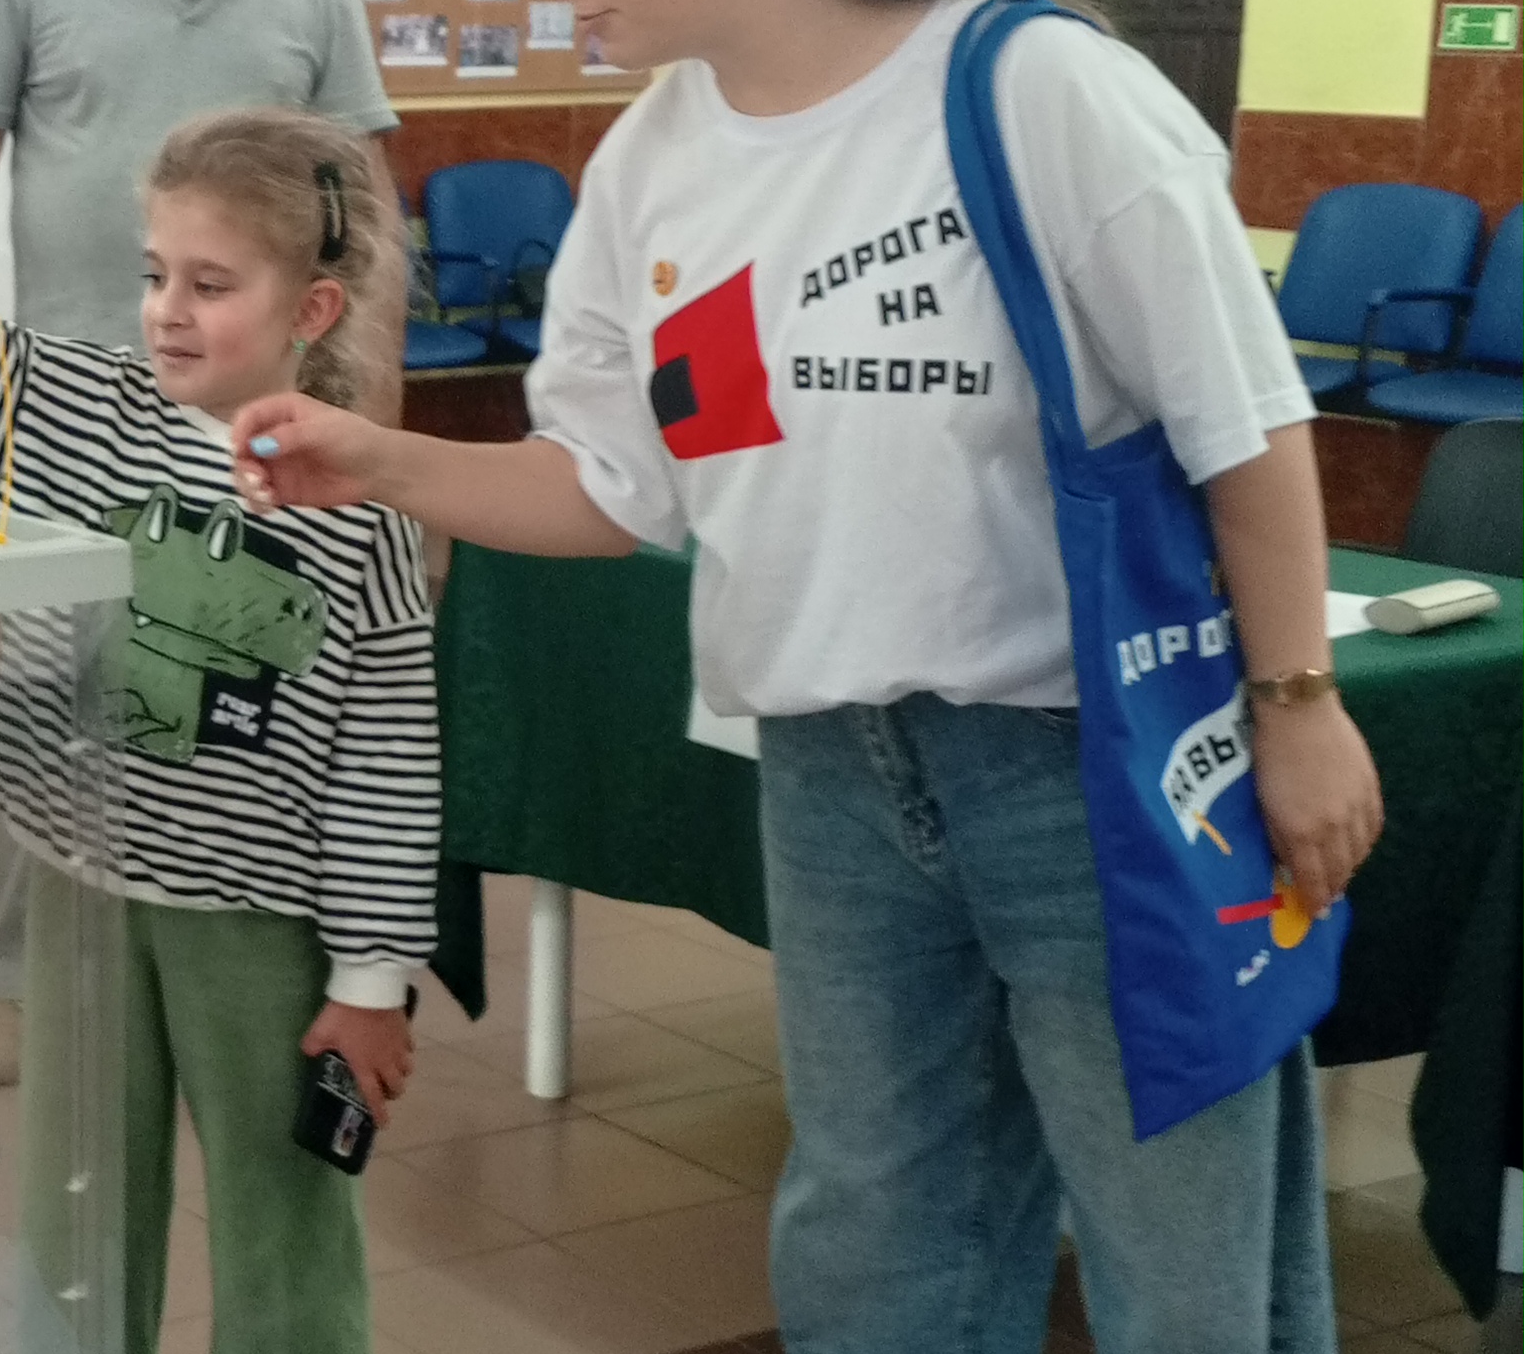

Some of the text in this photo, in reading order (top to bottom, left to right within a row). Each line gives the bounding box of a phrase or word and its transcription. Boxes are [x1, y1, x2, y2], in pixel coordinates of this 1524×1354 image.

[799, 207, 968, 308] ДОРОГА
[877, 283, 942, 327] НА
[792, 355, 994, 396] ВЫБОРЫ
